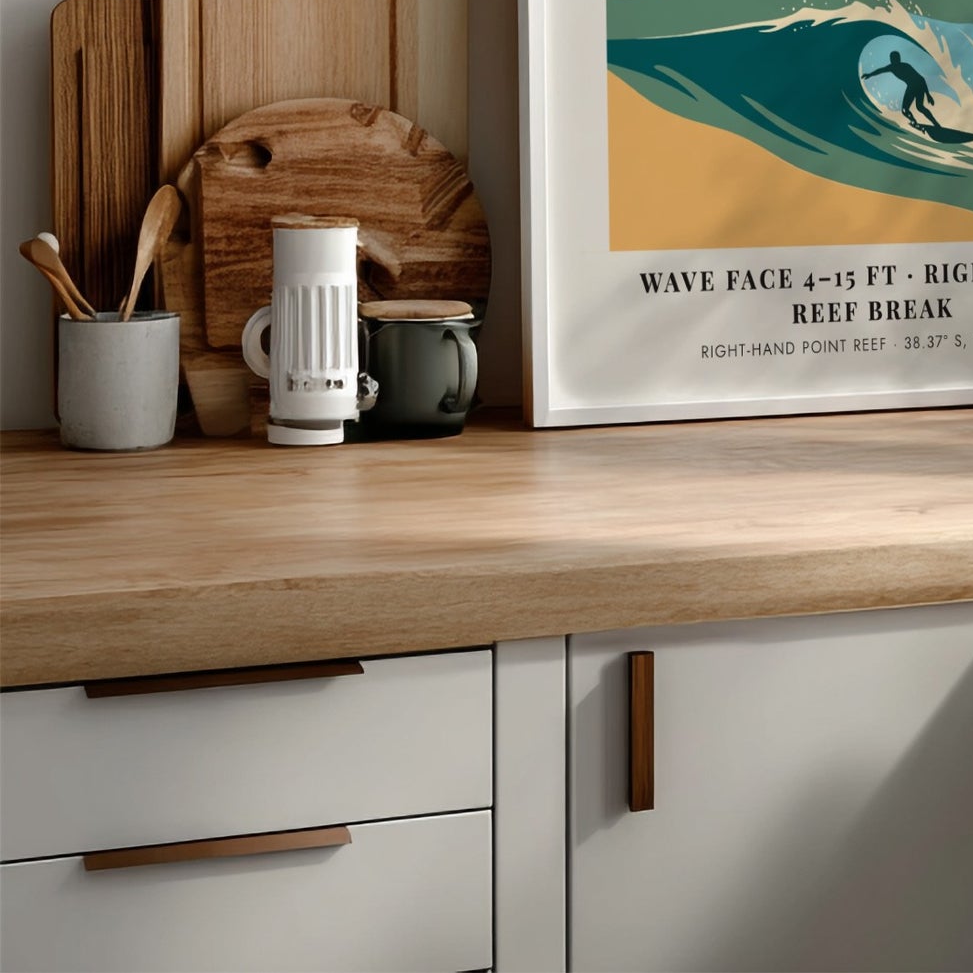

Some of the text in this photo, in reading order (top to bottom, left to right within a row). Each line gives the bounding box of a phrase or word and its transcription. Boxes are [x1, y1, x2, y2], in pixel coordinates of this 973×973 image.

[639, 270, 715, 294] WAVE
[725, 268, 793, 292] FACE
[866, 264, 897, 287] FT
[791, 297, 953, 325] REEF BREAK
[700, 341, 796, 359] RIGHT-HAND
[801, 338, 847, 354] POINT
[853, 337, 887, 352] REEF
[903, 334, 949, 350] 38.37°
[954, 333, 967, 350] S,
